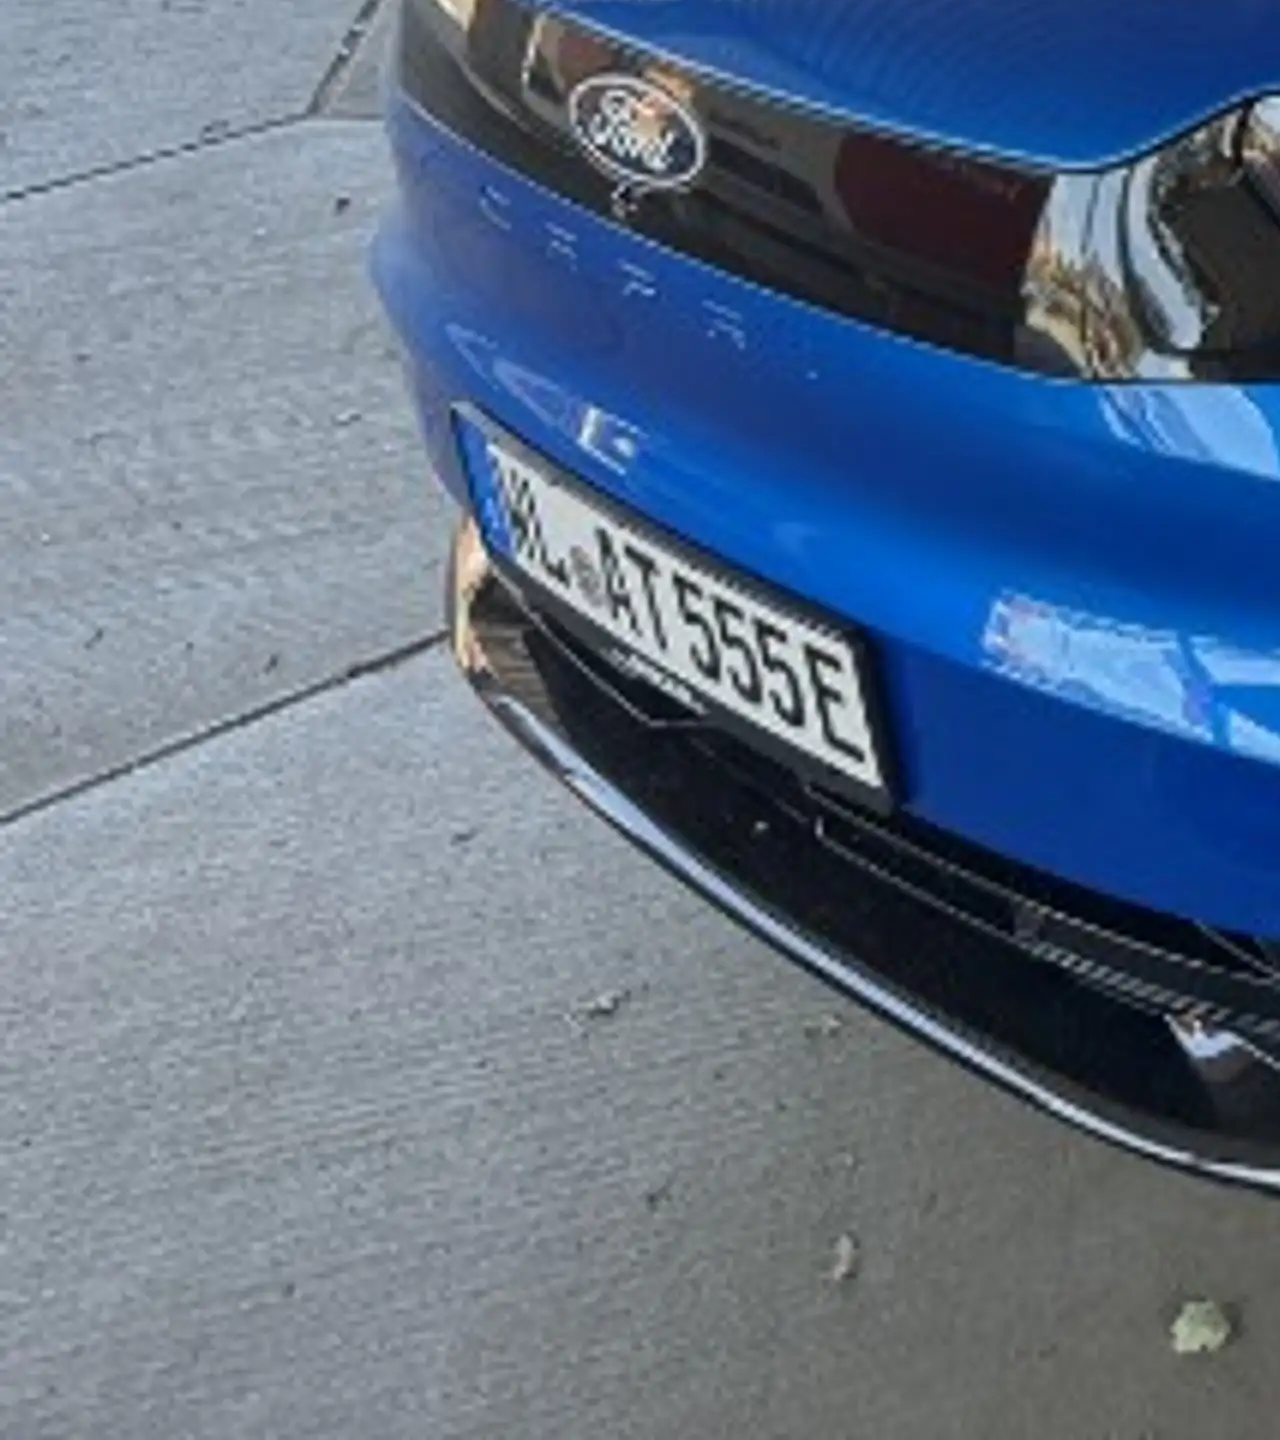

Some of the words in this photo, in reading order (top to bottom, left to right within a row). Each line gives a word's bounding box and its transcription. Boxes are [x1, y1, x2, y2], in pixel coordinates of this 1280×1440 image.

[587, 86, 678, 174] Ford
[594, 525, 668, 652] AT
[672, 570, 866, 764] 555E
